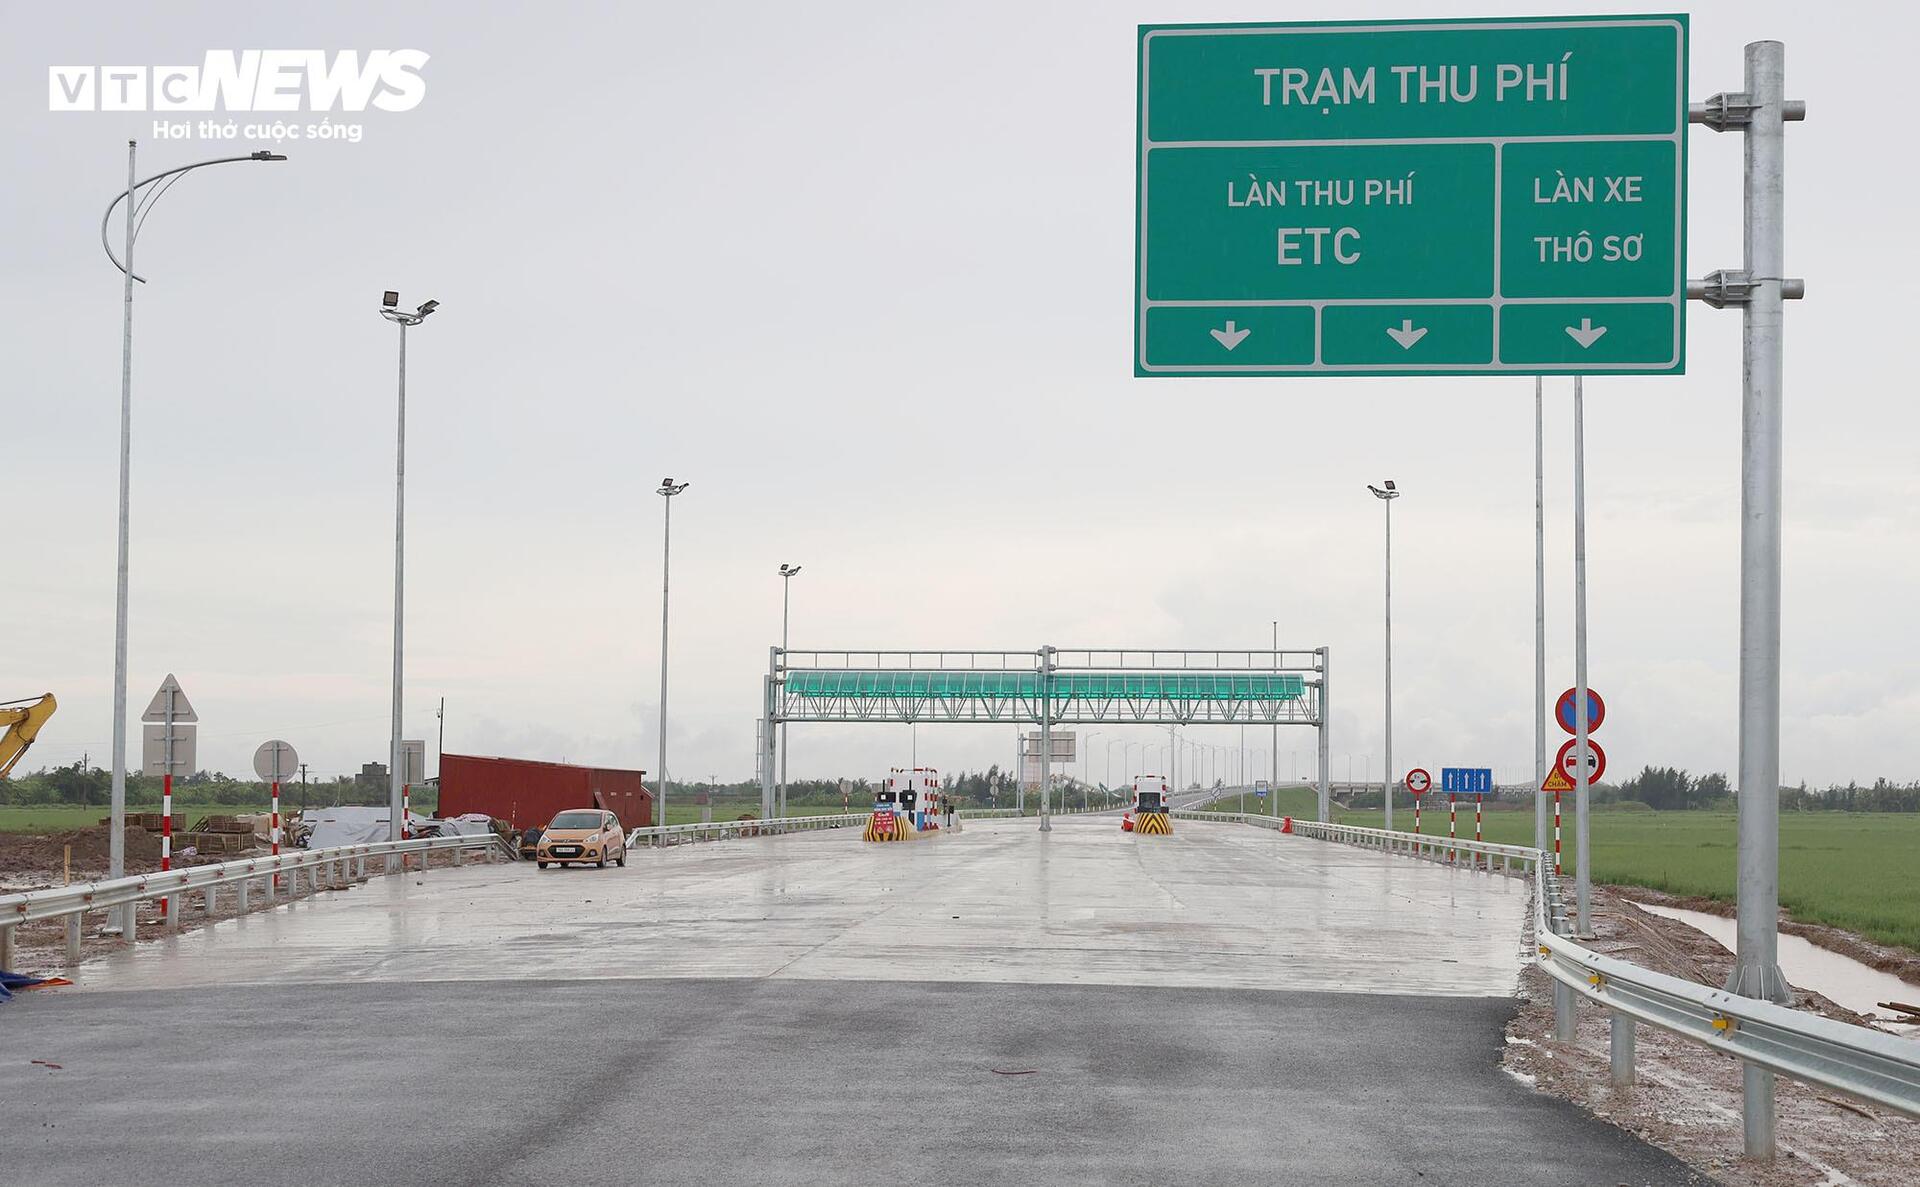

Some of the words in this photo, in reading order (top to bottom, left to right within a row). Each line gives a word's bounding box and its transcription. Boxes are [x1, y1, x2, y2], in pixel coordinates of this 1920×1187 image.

[1254, 66, 1376, 115] TRẠM
[1390, 65, 1478, 104] THU
[1496, 51, 1573, 102] PHÍ
[1228, 173, 1286, 207] LÀN
[1294, 179, 1355, 206] THU
[1364, 171, 1415, 205] PHÍ
[1534, 170, 1594, 203] LÀN
[1603, 176, 1643, 202] XE
[1277, 226, 1361, 265] ETC
[1534, 230, 1593, 263] THÔ
[1602, 233, 1644, 262] SƠ
